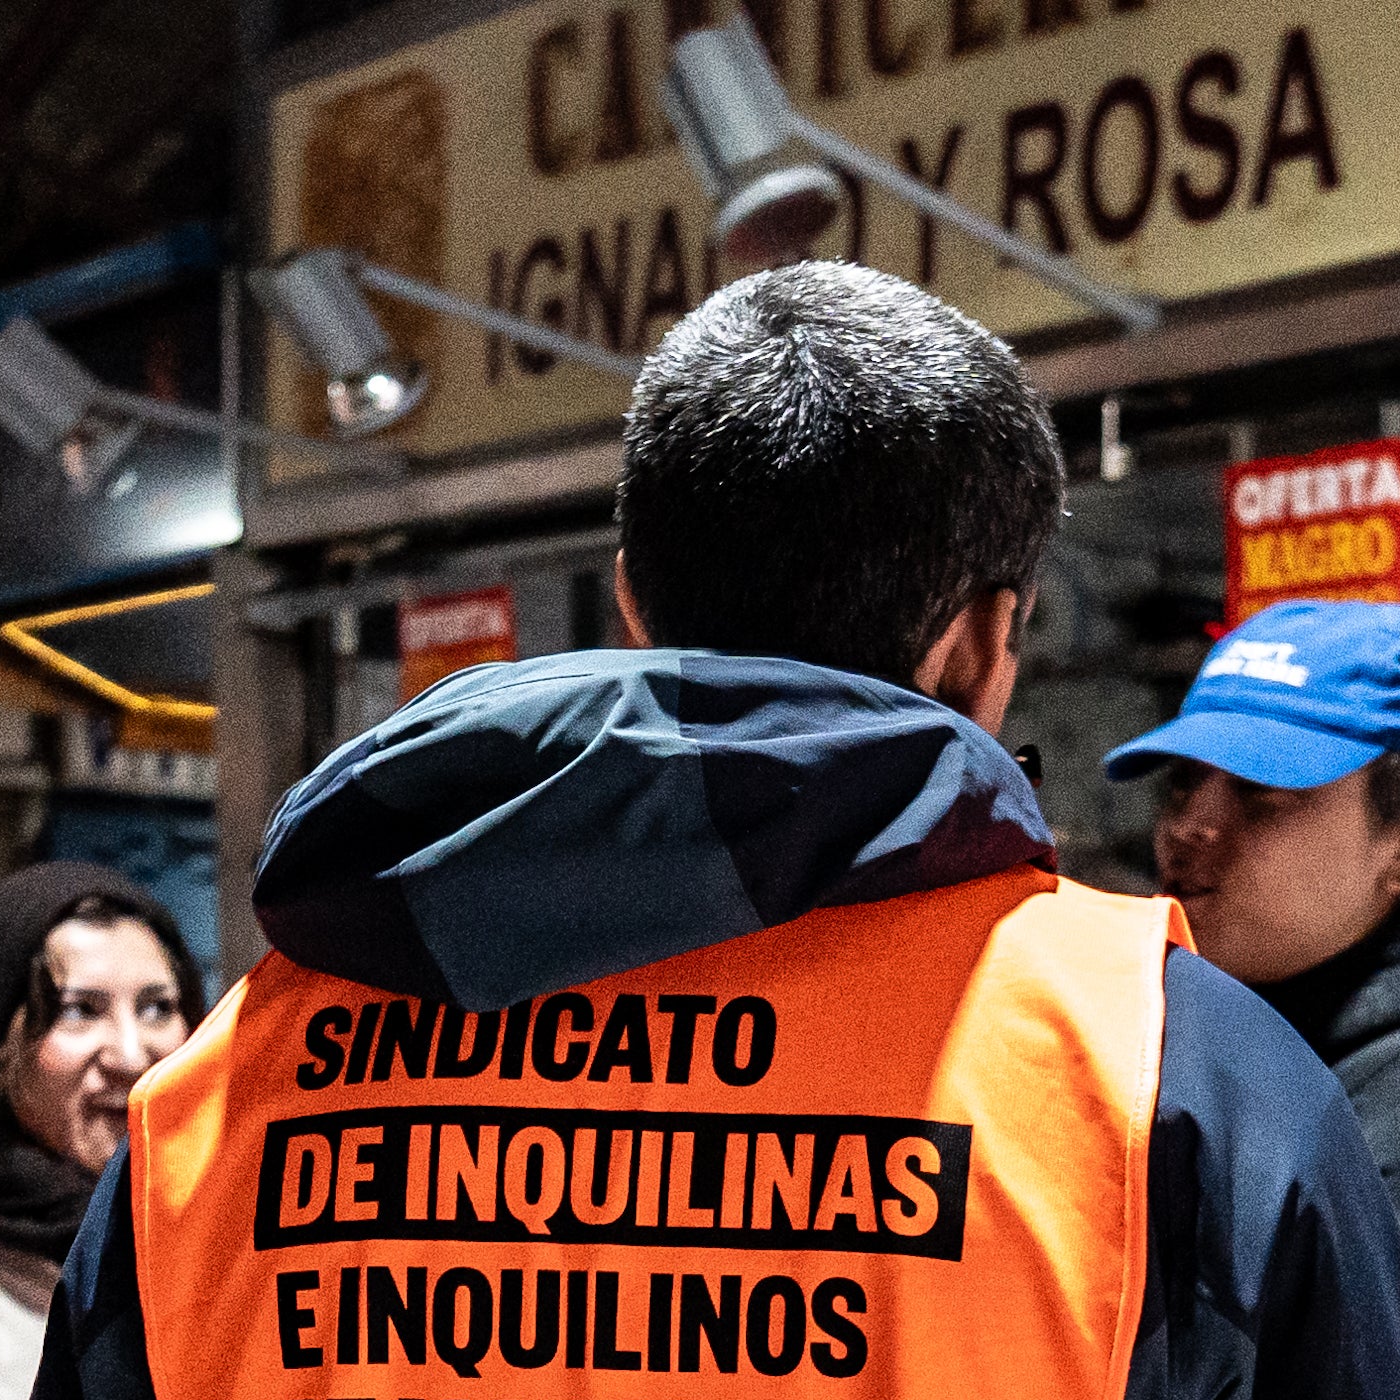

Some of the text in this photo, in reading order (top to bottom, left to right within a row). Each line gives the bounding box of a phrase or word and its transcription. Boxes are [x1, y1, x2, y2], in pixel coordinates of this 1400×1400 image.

[900, 120, 966, 286] Y
[1003, 24, 1342, 268] ROSA
[295, 993, 777, 1091] SINDICATO
[279, 1124, 943, 1237] DE INQUILINAS
[276, 1265, 870, 1378] E INQUILINOS
